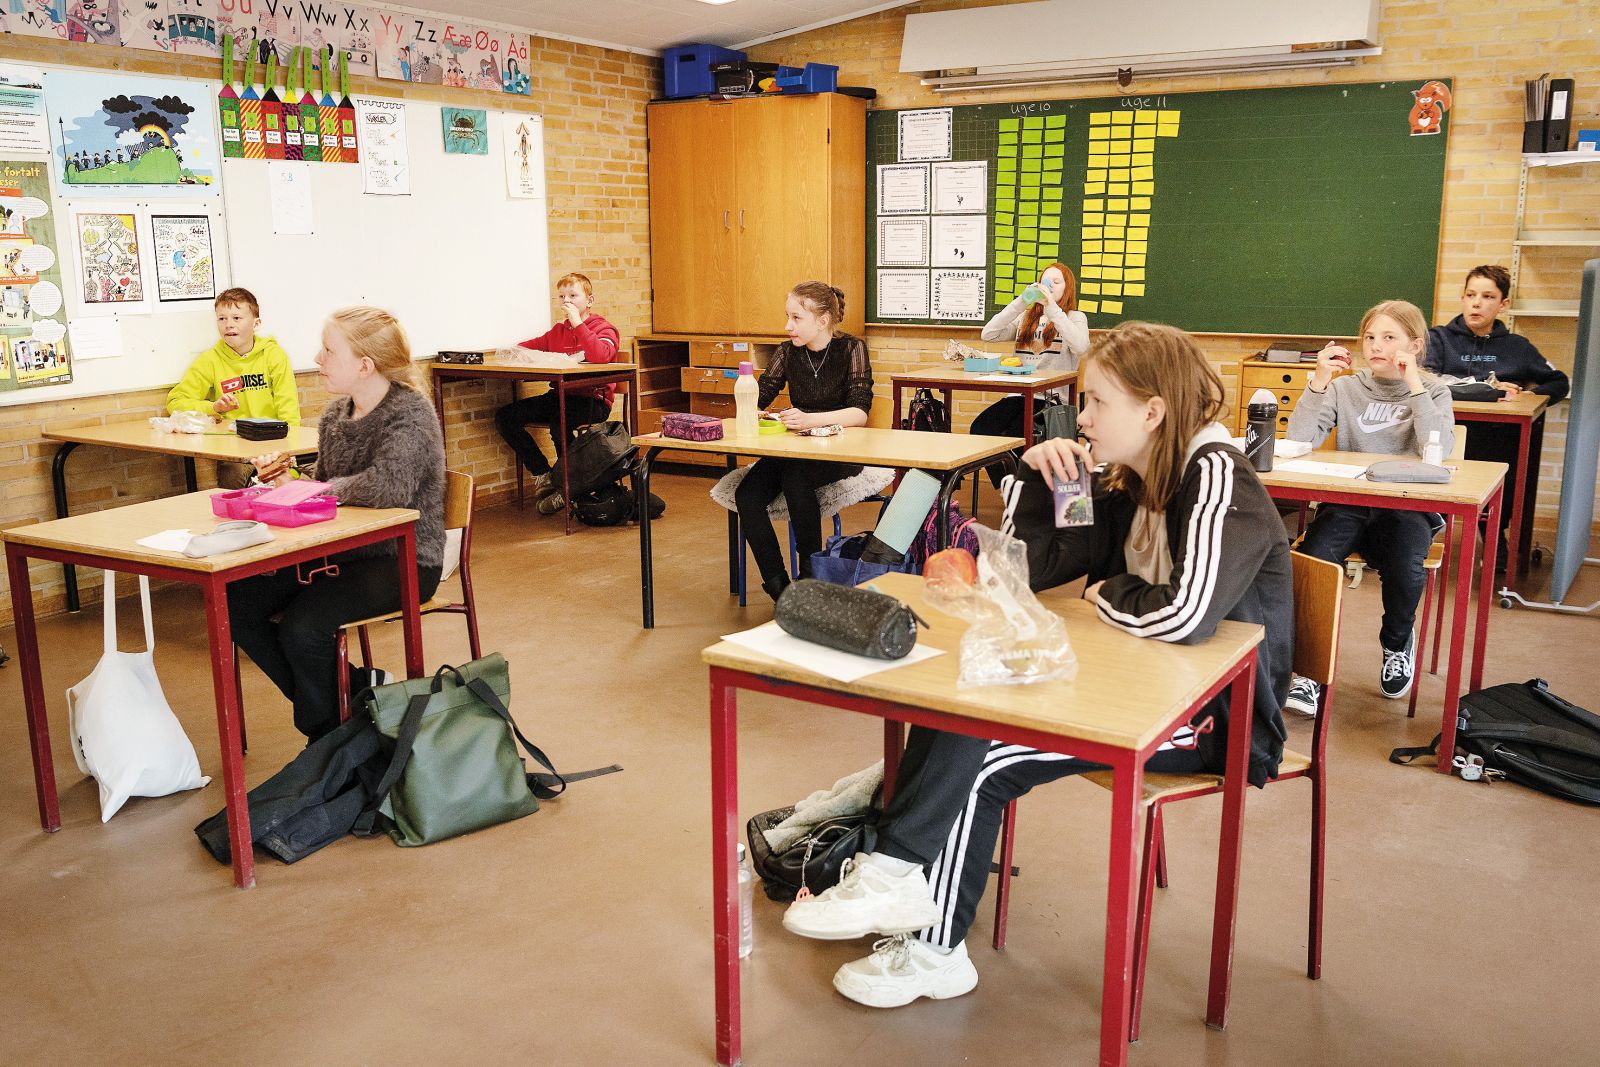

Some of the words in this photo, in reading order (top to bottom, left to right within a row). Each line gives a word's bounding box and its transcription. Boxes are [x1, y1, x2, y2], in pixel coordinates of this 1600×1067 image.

[1121, 97, 1151, 108] uge
[1157, 96, 1167, 108] 11
[1011, 103, 1035, 118] uge
[1039, 103, 1051, 111] 10
[4, 167, 41, 177] fortalt
[1461, 354, 1471, 362] LE
[1363, 402, 1408, 422] NIKE
